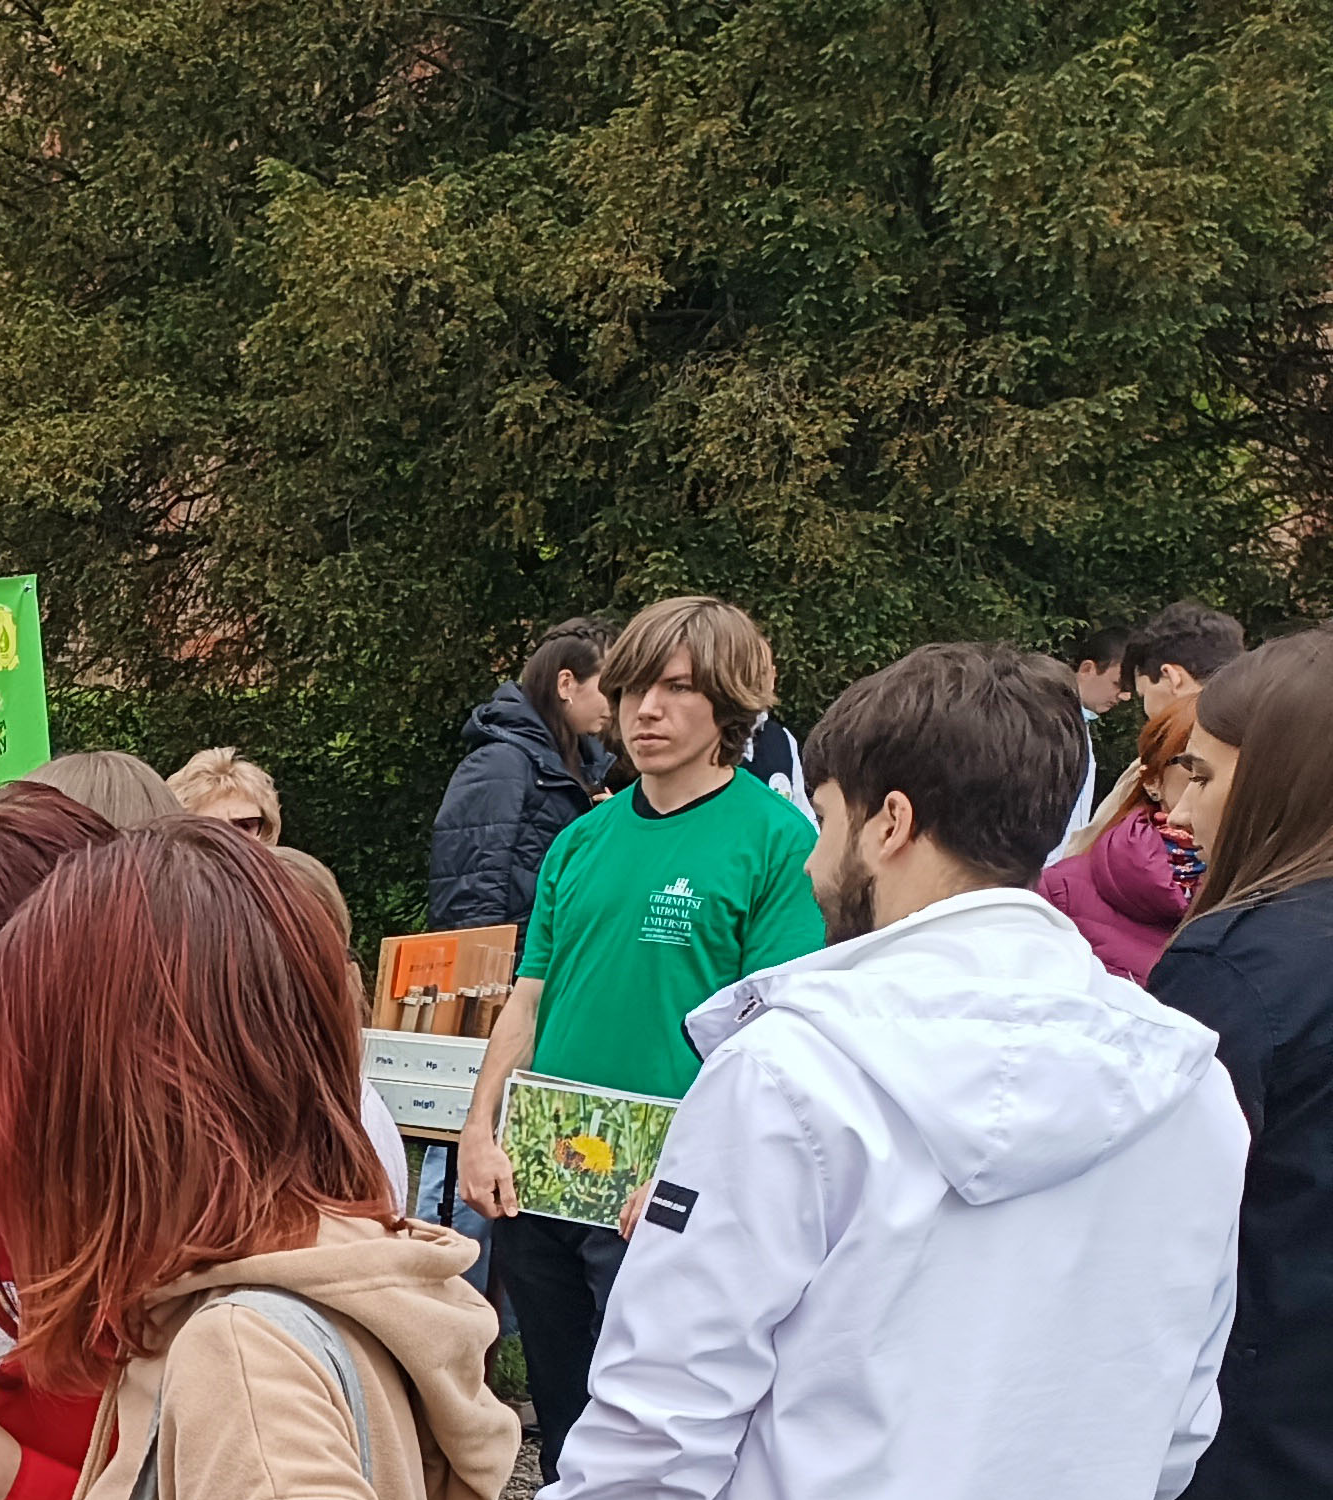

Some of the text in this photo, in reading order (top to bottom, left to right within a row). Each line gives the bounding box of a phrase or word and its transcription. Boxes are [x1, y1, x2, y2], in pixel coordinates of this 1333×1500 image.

[650, 894, 701, 909] CHERNIVTSI
[651, 905, 690, 919] NATIONAL
[644, 917, 692, 931] UNIVERSITY
